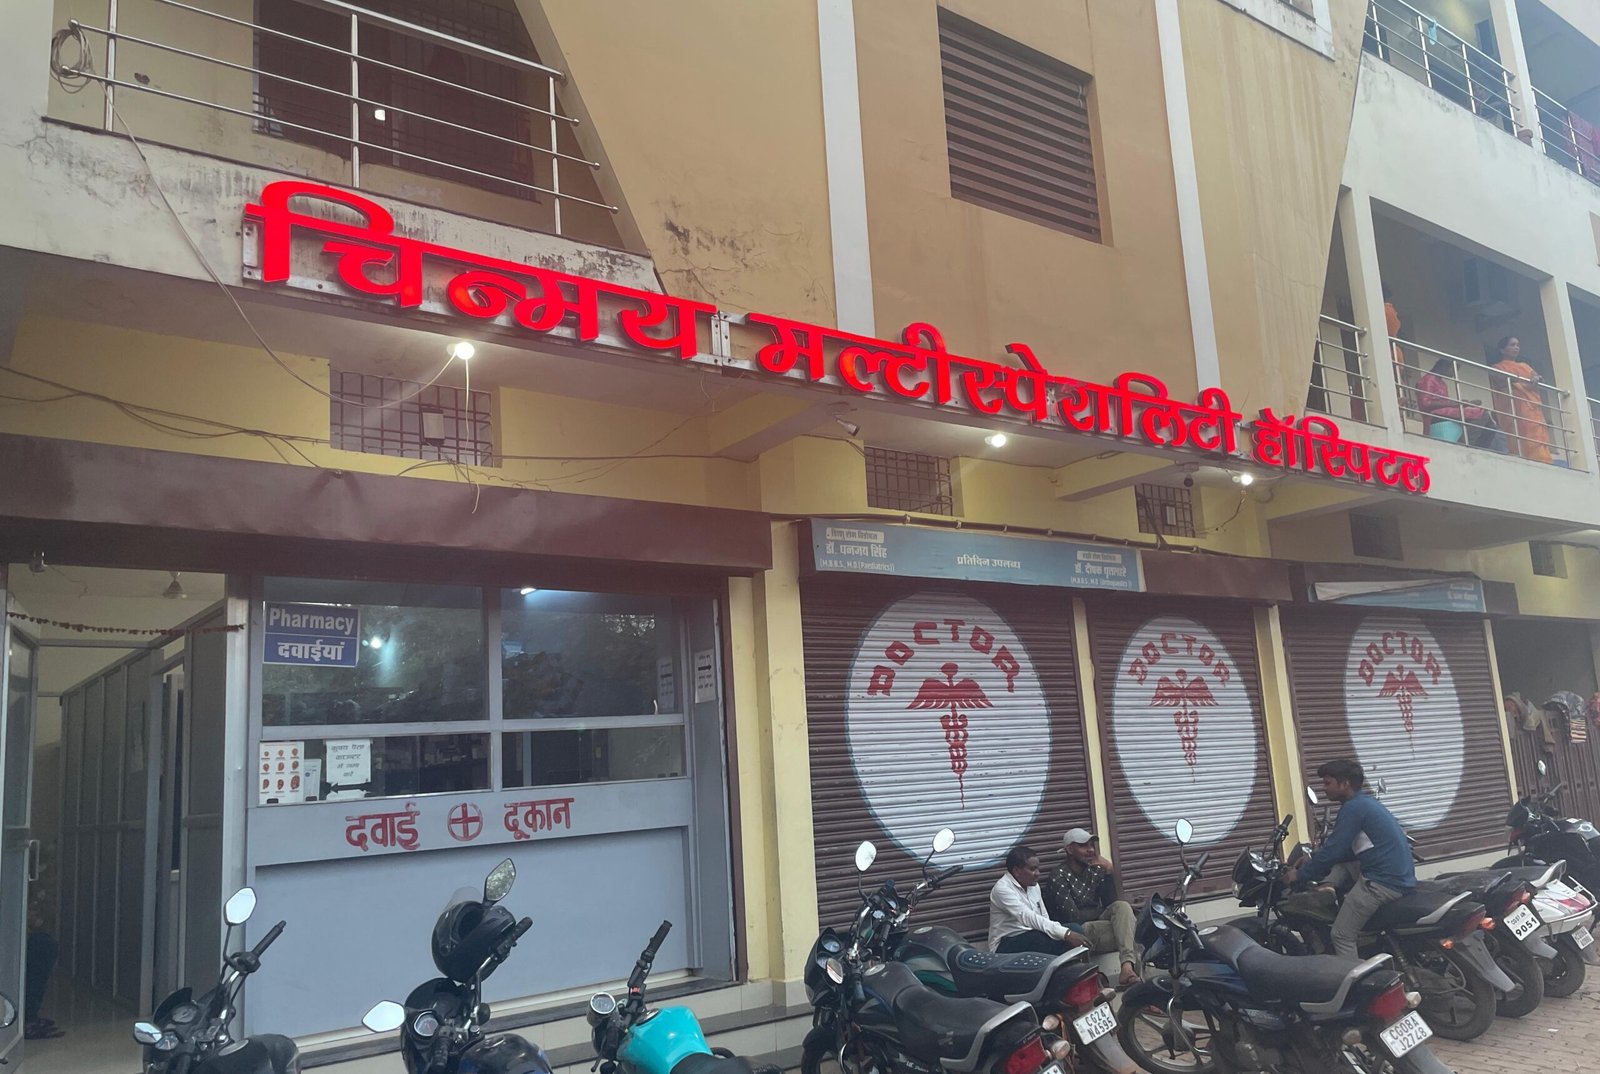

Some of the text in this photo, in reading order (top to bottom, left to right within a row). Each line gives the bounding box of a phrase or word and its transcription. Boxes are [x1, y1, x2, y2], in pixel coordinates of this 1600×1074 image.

[245, 181, 1431, 495] चिन्मय मल्टीस्पेशालिटी हॉस्पिटल
[870, 543, 888, 558] सिंह
[957, 554, 1021, 569] प्रतिदिन उपलब्ध
[269, 607, 354, 635] Pharmacy
[277, 639, 345, 662] दवाईयां
[345, 797, 575, 852] दवाई दूकान
[1515, 917, 1537, 937] 9051
[1085, 1008, 1107, 1027] CG24
[1087, 1017, 1114, 1040] N4595
[1389, 1016, 1420, 1040] CG08A
[1398, 1026, 1427, 1051] J2748
